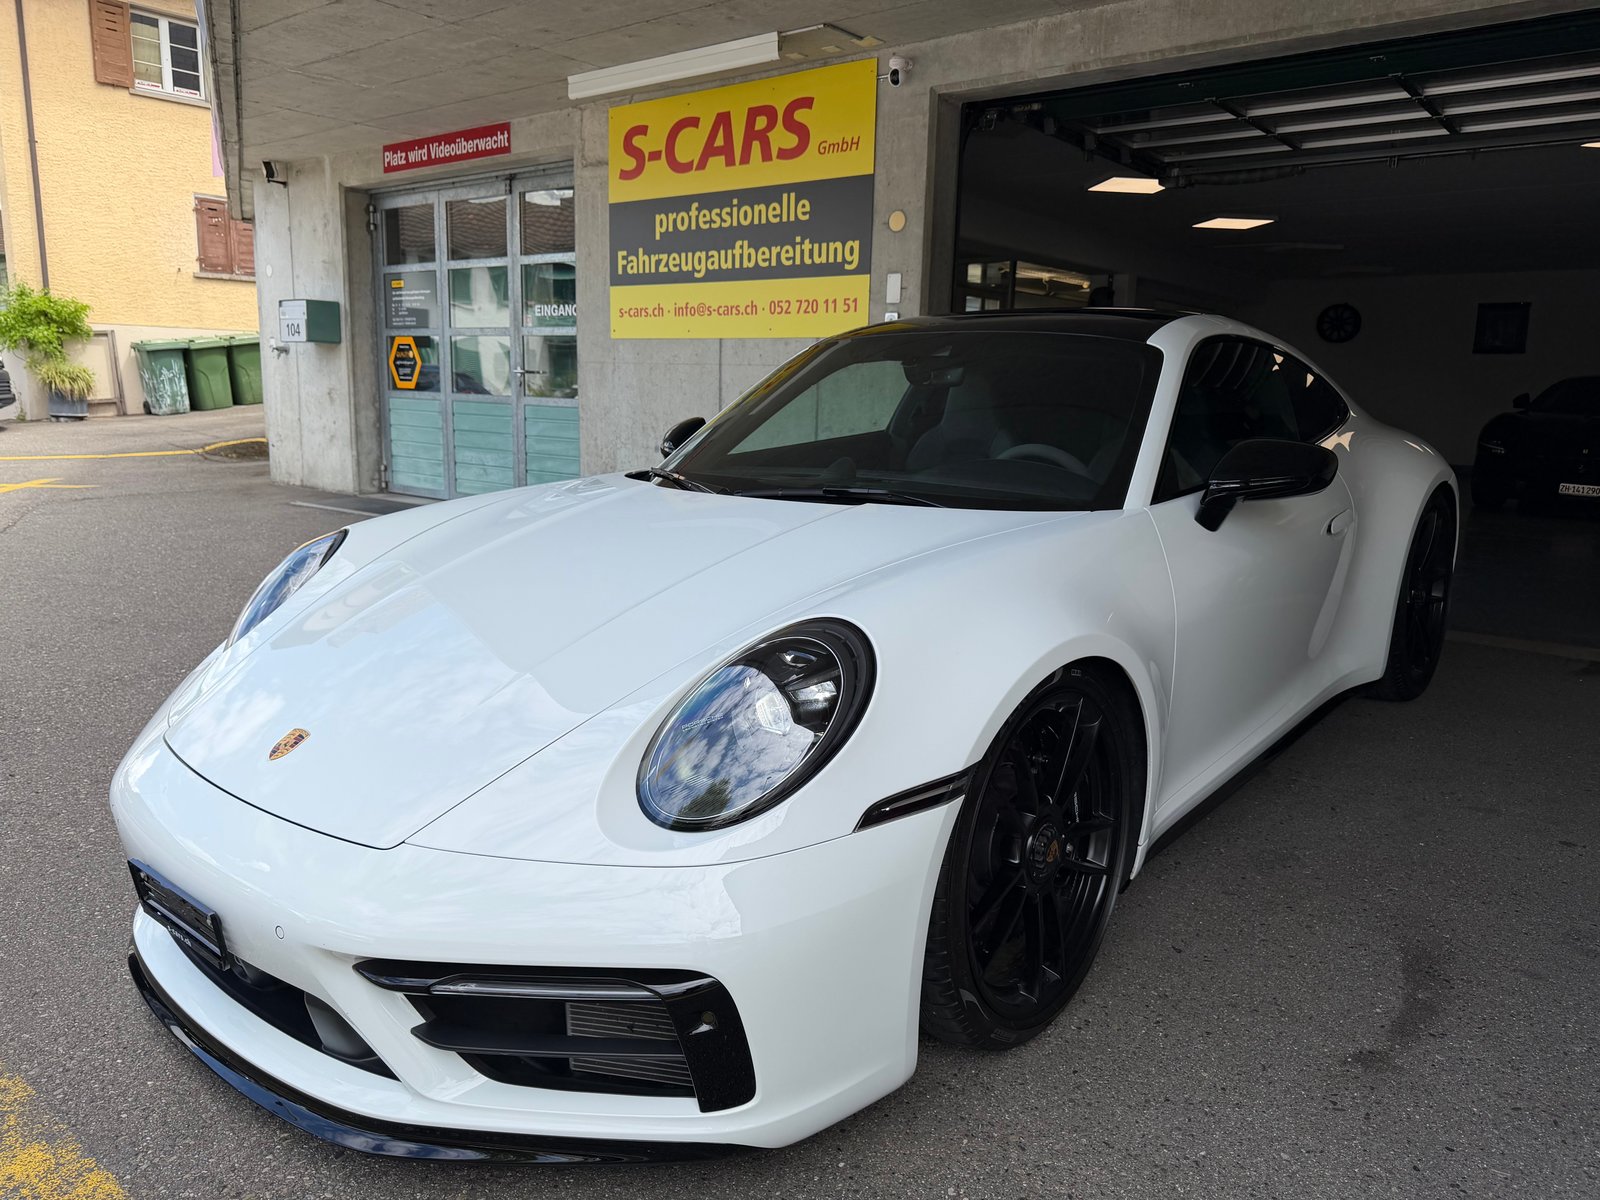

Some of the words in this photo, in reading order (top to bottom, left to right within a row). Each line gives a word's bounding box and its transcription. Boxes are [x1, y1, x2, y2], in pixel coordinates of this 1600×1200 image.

[384, 150, 406, 167] Platz
[408, 145, 428, 163] wird
[429, 130, 509, 160] Videoüberwacht
[618, 96, 815, 181] S-CARS
[817, 136, 861, 155] GmbH
[655, 192, 811, 240] professionelle
[617, 236, 860, 278] Fahrzeugaufbereitung
[619, 303, 664, 318] s-cars.ch
[673, 300, 758, 317] info@s-cars.ch
[769, 300, 792, 316] 052
[796, 299, 819, 315] 720
[823, 298, 837, 313] 11
[843, 297, 858, 313] 51
[286, 323, 301, 337] 104
